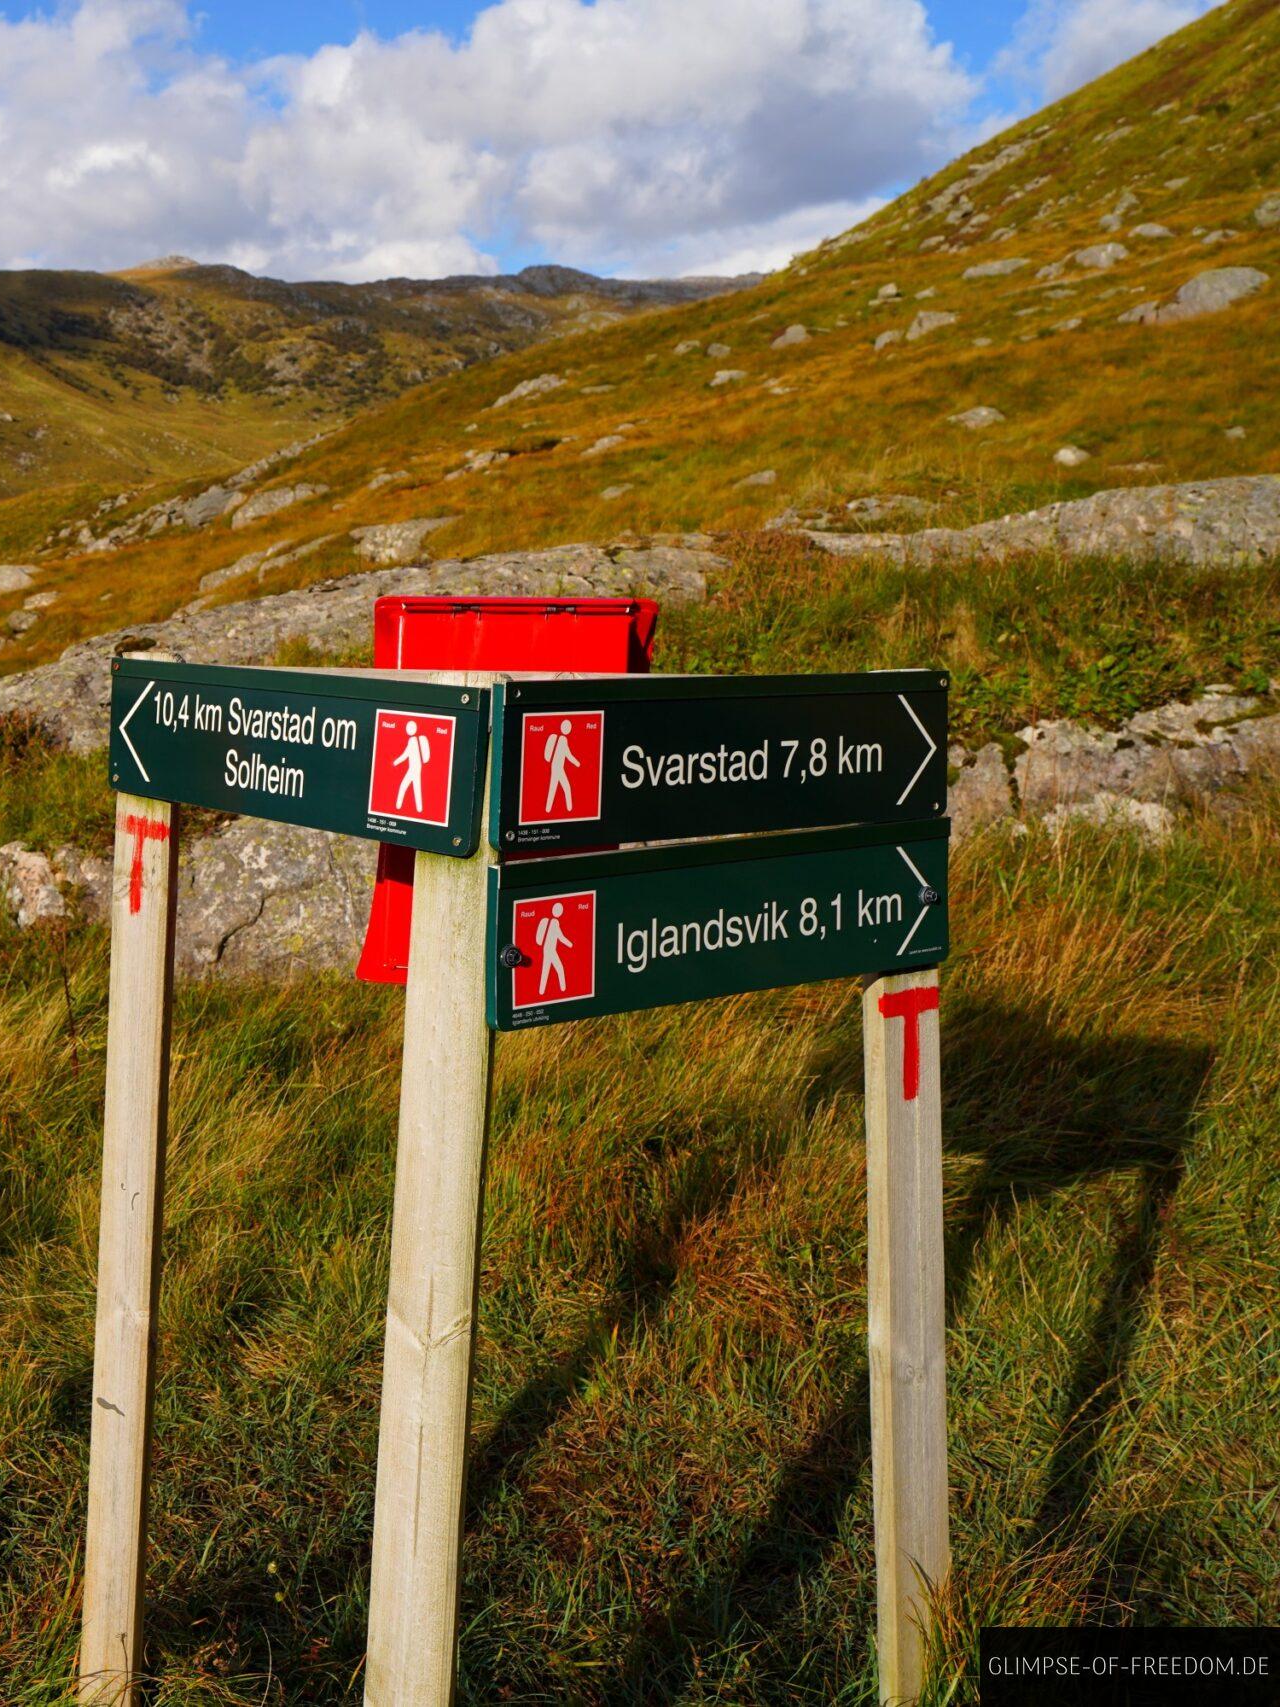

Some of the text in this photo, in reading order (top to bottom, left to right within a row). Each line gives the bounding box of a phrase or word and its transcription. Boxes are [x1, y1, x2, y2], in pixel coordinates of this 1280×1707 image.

[154, 690, 358, 751] 10,4 km Svarstad om
[529, 724, 544, 732] Raud
[224, 748, 305, 798] Solheim
[620, 735, 884, 789] Svarstad 7,8 km
[520, 910, 536, 918] Raud
[617, 889, 903, 973] Iglandsvik 8,1 km
[878, 986, 940, 1101] T
